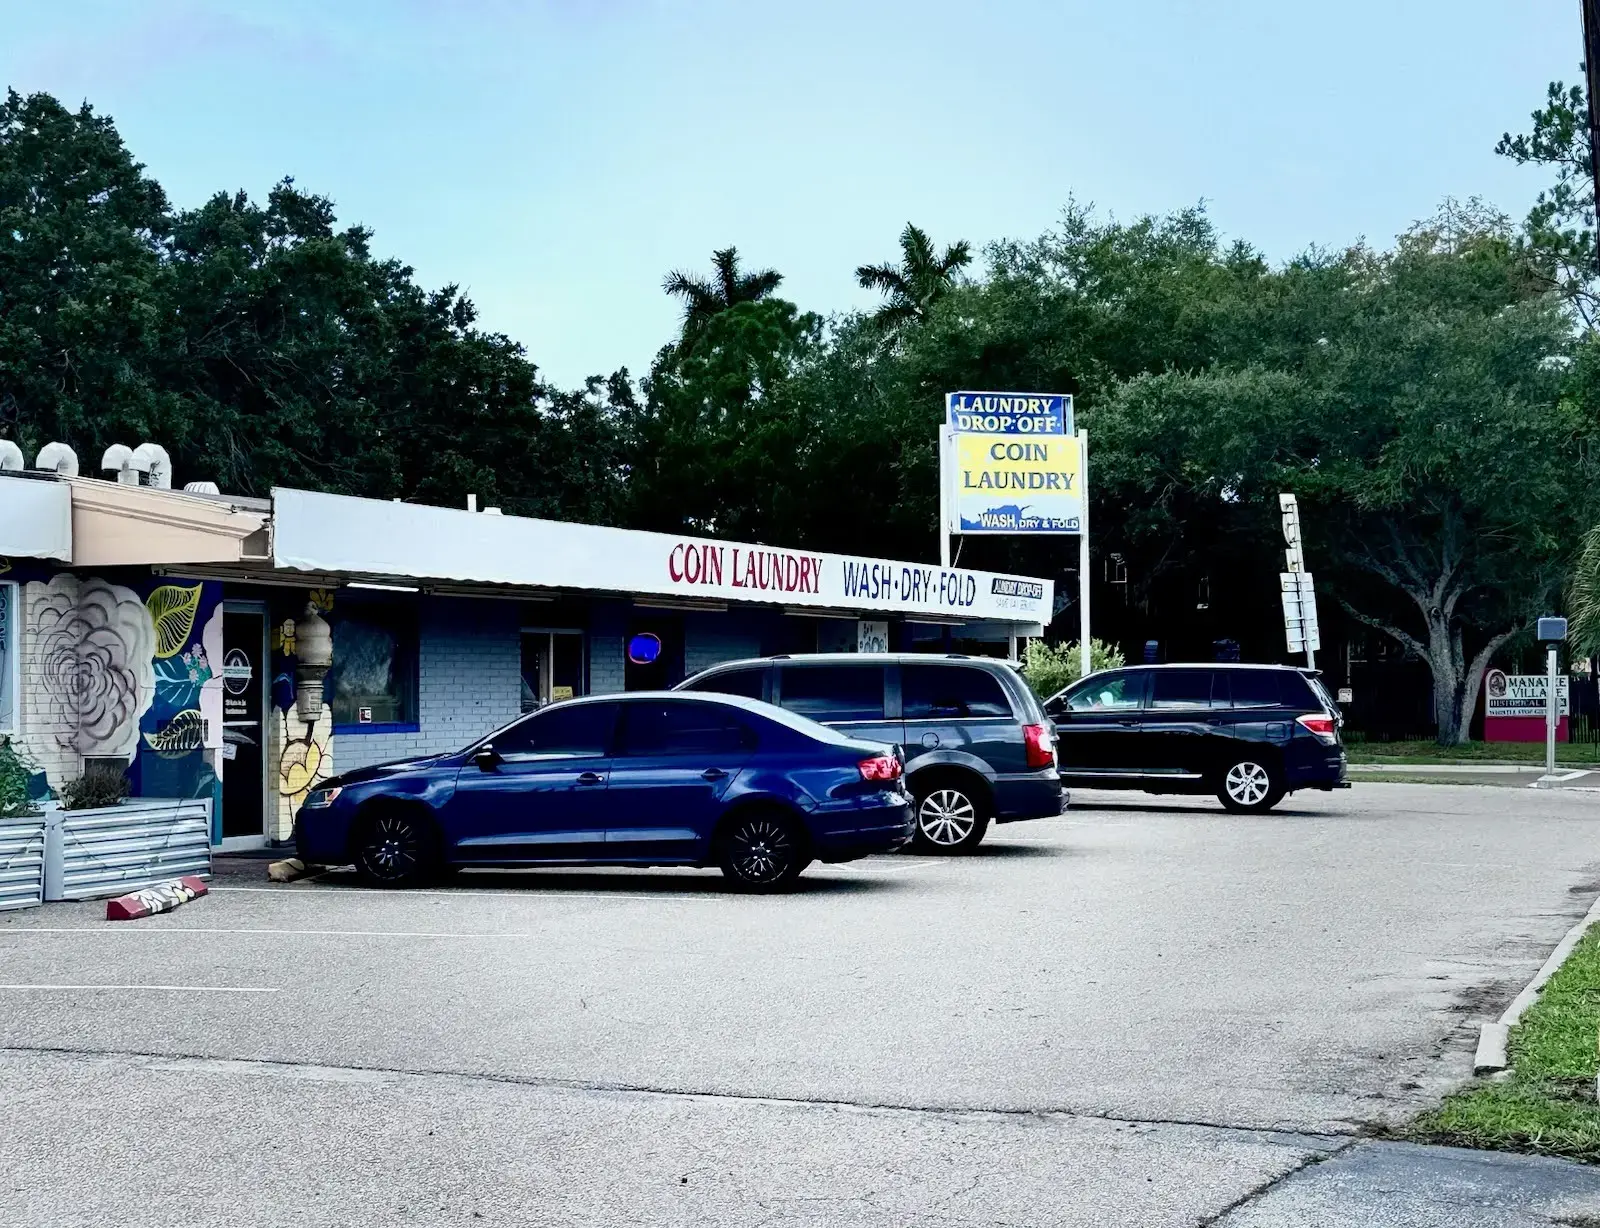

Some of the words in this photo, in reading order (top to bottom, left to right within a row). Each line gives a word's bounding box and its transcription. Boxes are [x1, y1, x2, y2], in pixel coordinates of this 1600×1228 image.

[959, 396, 1054, 414] LAUNDRY
[990, 443, 1049, 462] COIN
[963, 470, 1076, 490] LAUNDRY
[1019, 519, 1040, 528] DRY
[1042, 519, 1050, 528] &
[1052, 519, 1079, 529] FOLD
[669, 543, 725, 586] COIN
[731, 548, 823, 594] LAUNDRY
[1512, 688, 1564, 698] VILLAE
